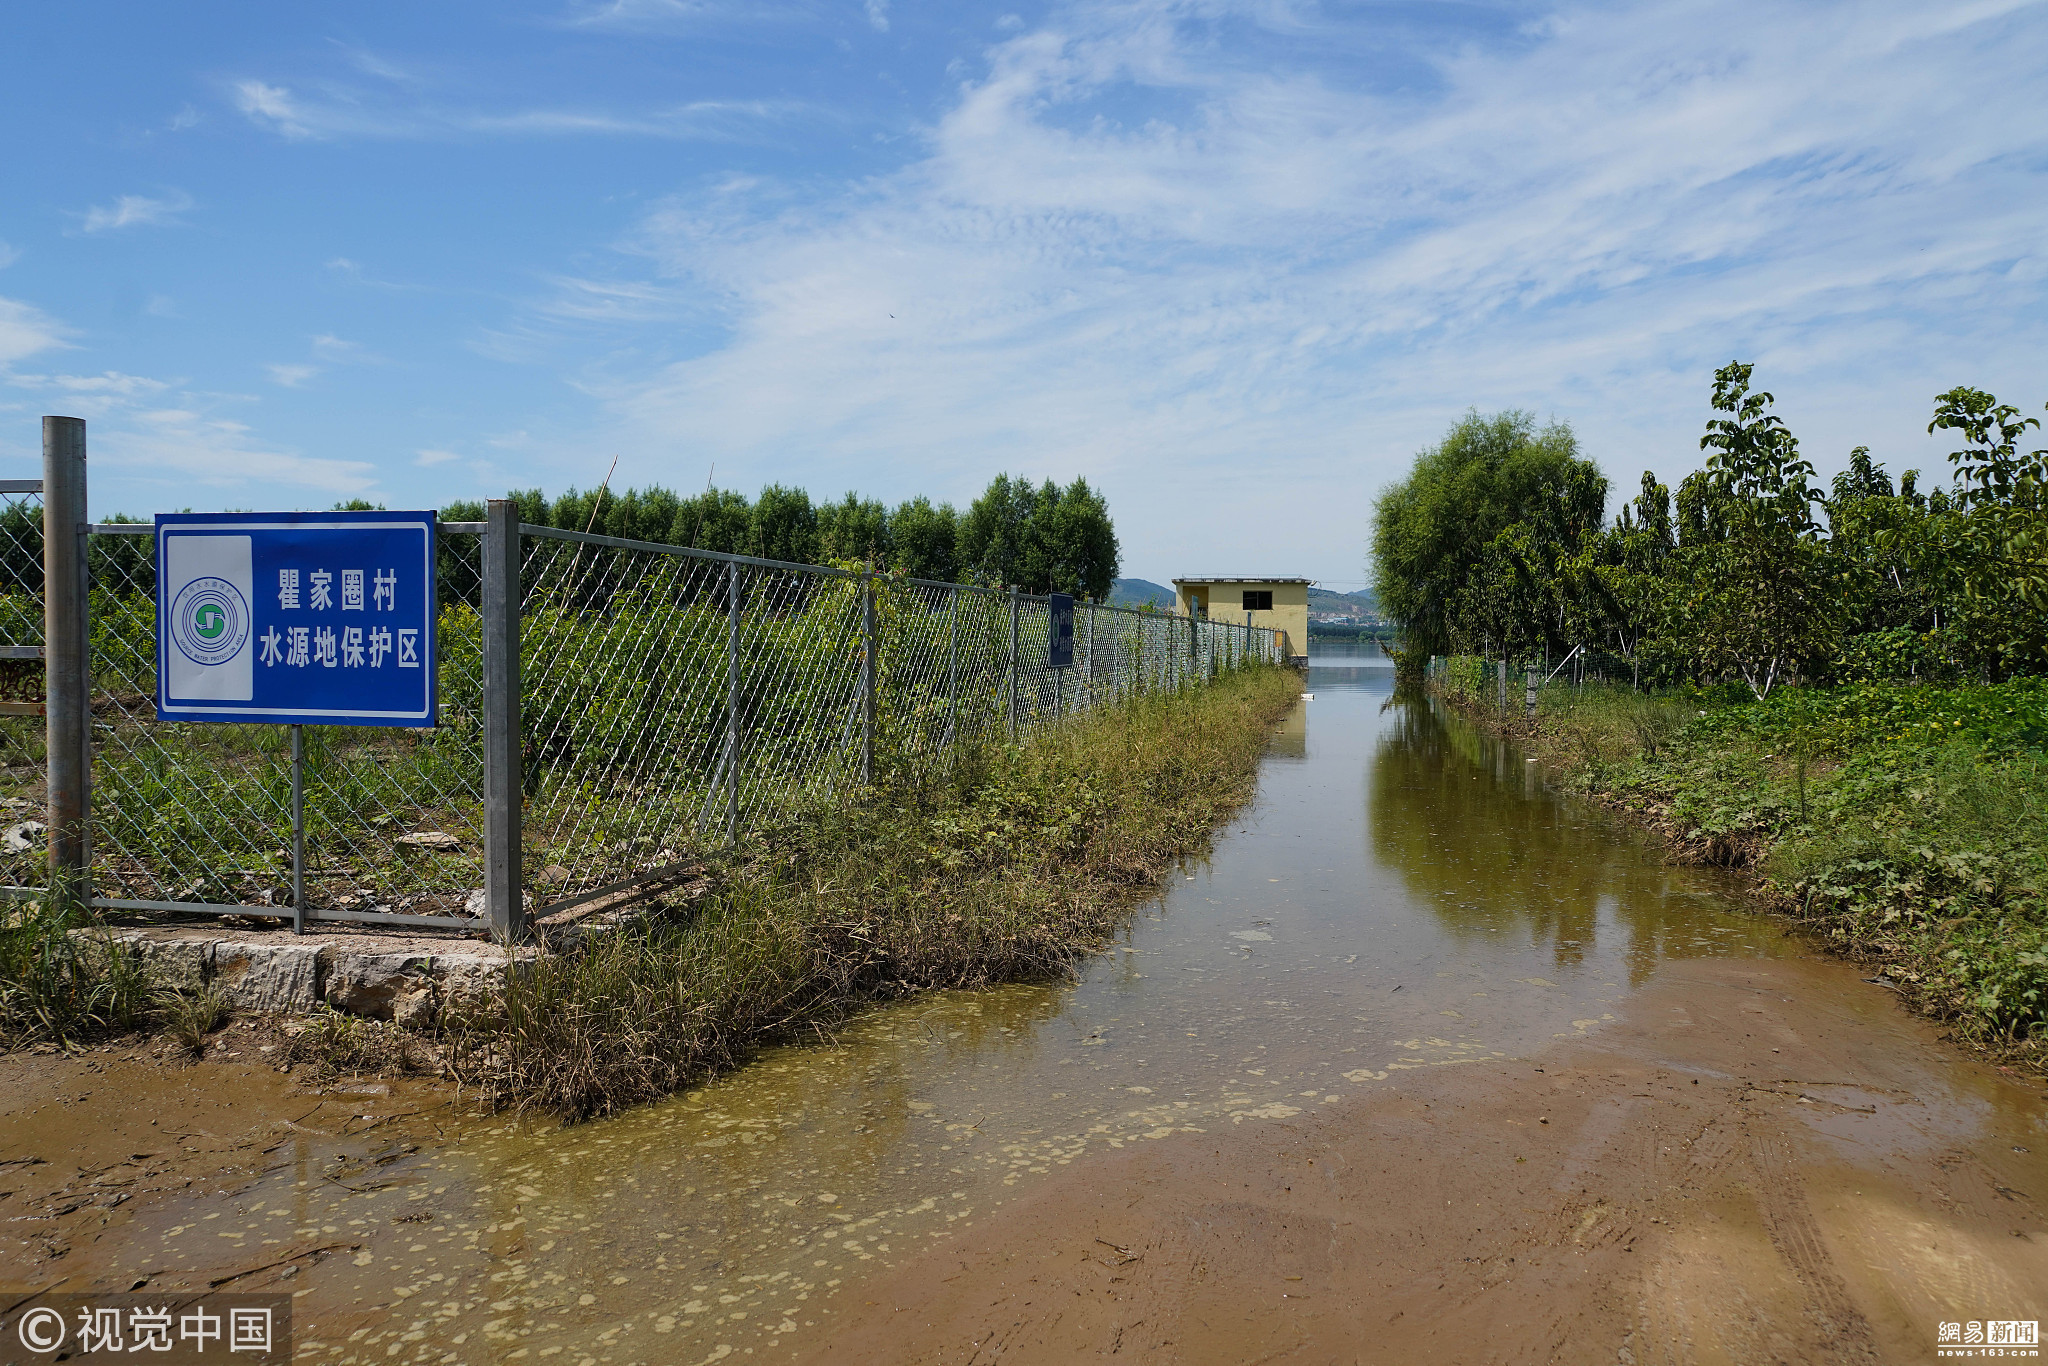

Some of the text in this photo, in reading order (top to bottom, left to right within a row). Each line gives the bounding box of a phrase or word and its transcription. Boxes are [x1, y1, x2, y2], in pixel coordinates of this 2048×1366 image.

[277, 568, 397, 611] 瞿家圈村
[194, 653, 209, 662] WATER
[210, 646, 236, 662] PROTECTION
[235, 633, 244, 647] AREA
[259, 625, 420, 668] 水源地保护区
